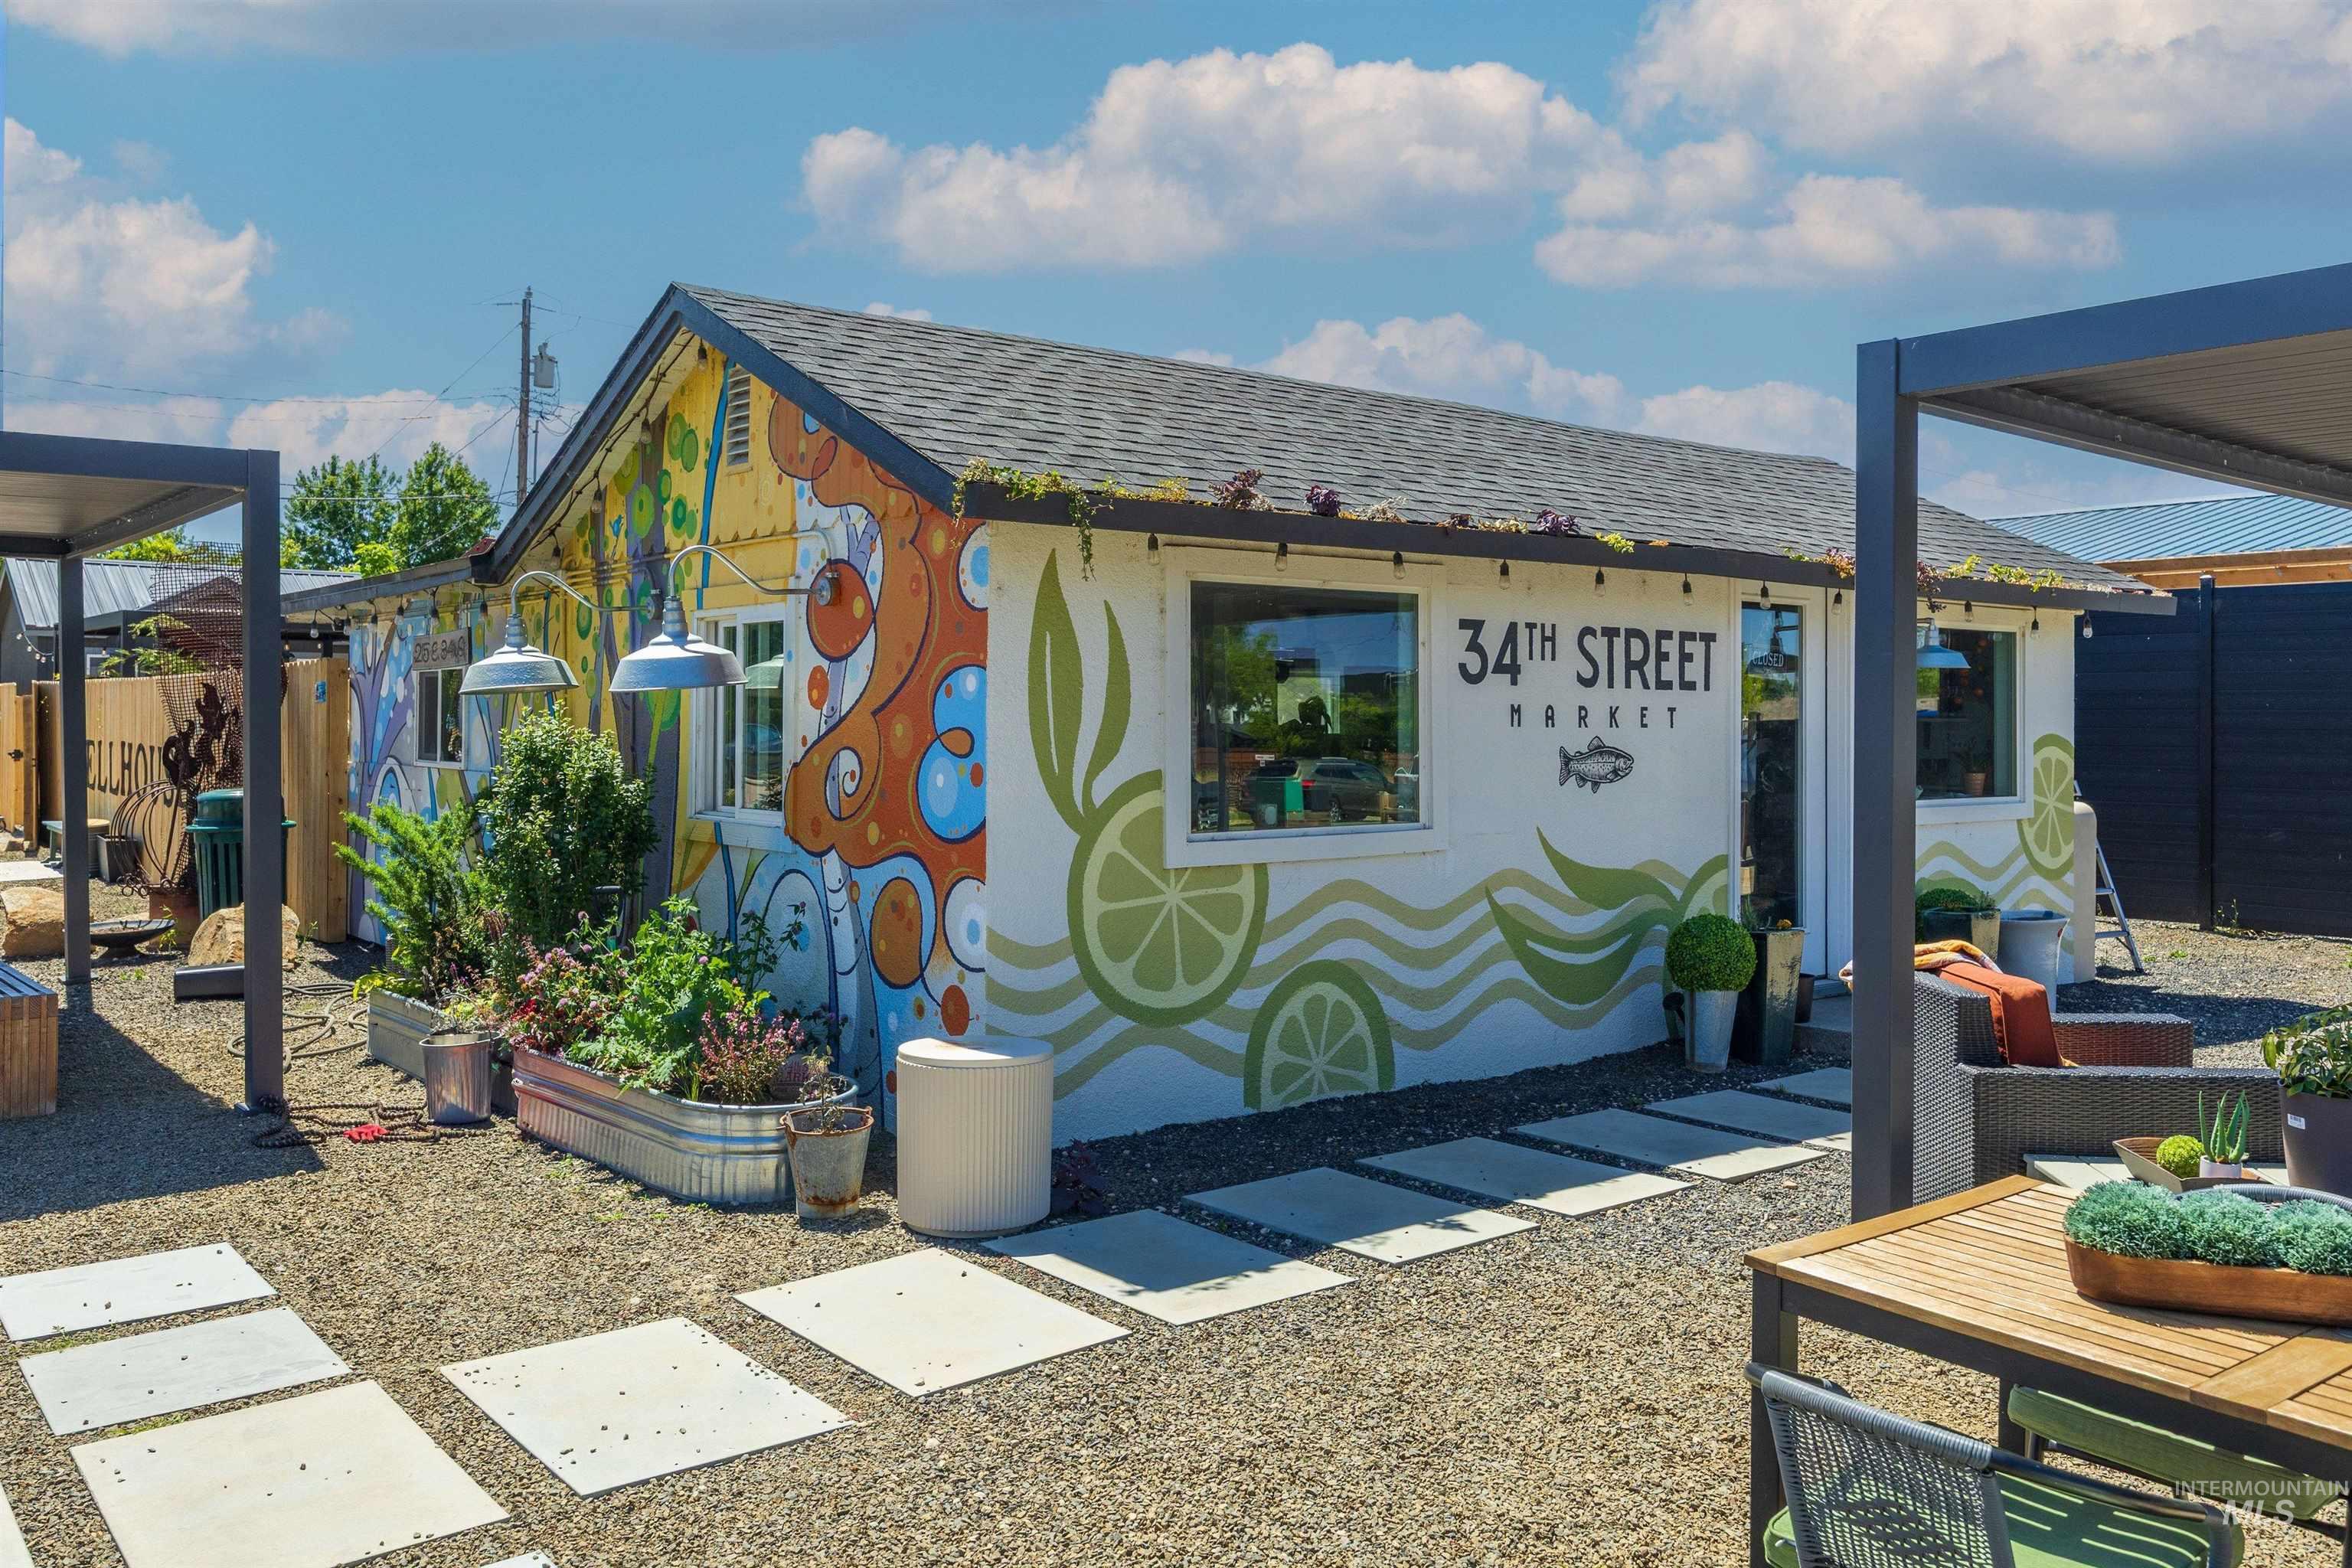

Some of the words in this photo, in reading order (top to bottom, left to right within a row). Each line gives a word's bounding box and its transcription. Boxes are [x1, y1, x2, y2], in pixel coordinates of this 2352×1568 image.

[1458, 618, 1557, 686] 34TH
[1576, 626, 1717, 691] STREET
[1753, 651, 1784, 667] CLOSED
[1510, 704, 1677, 728] MARKET
